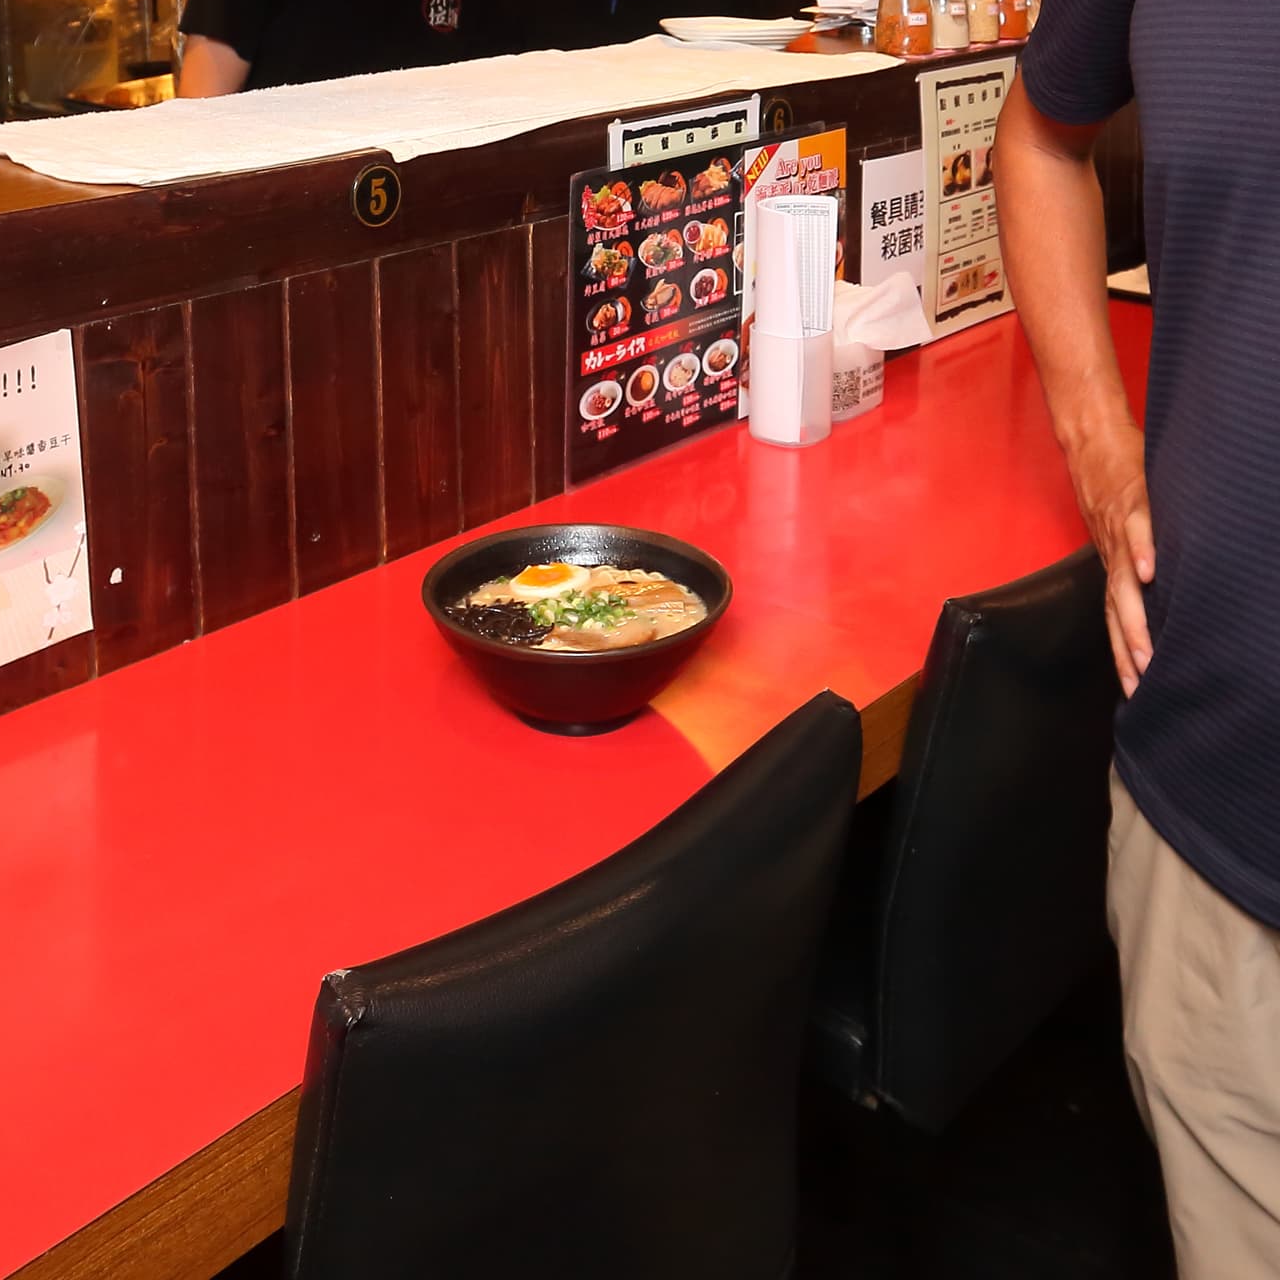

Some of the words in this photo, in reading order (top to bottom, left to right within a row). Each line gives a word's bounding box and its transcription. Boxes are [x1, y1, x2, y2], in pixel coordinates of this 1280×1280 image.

[747, 148, 768, 186] NEW
[776, 158, 798, 180] Are
[800, 154, 822, 177] you
[370, 177, 387, 215] 5
[584, 337, 646, 370] カレーライス
